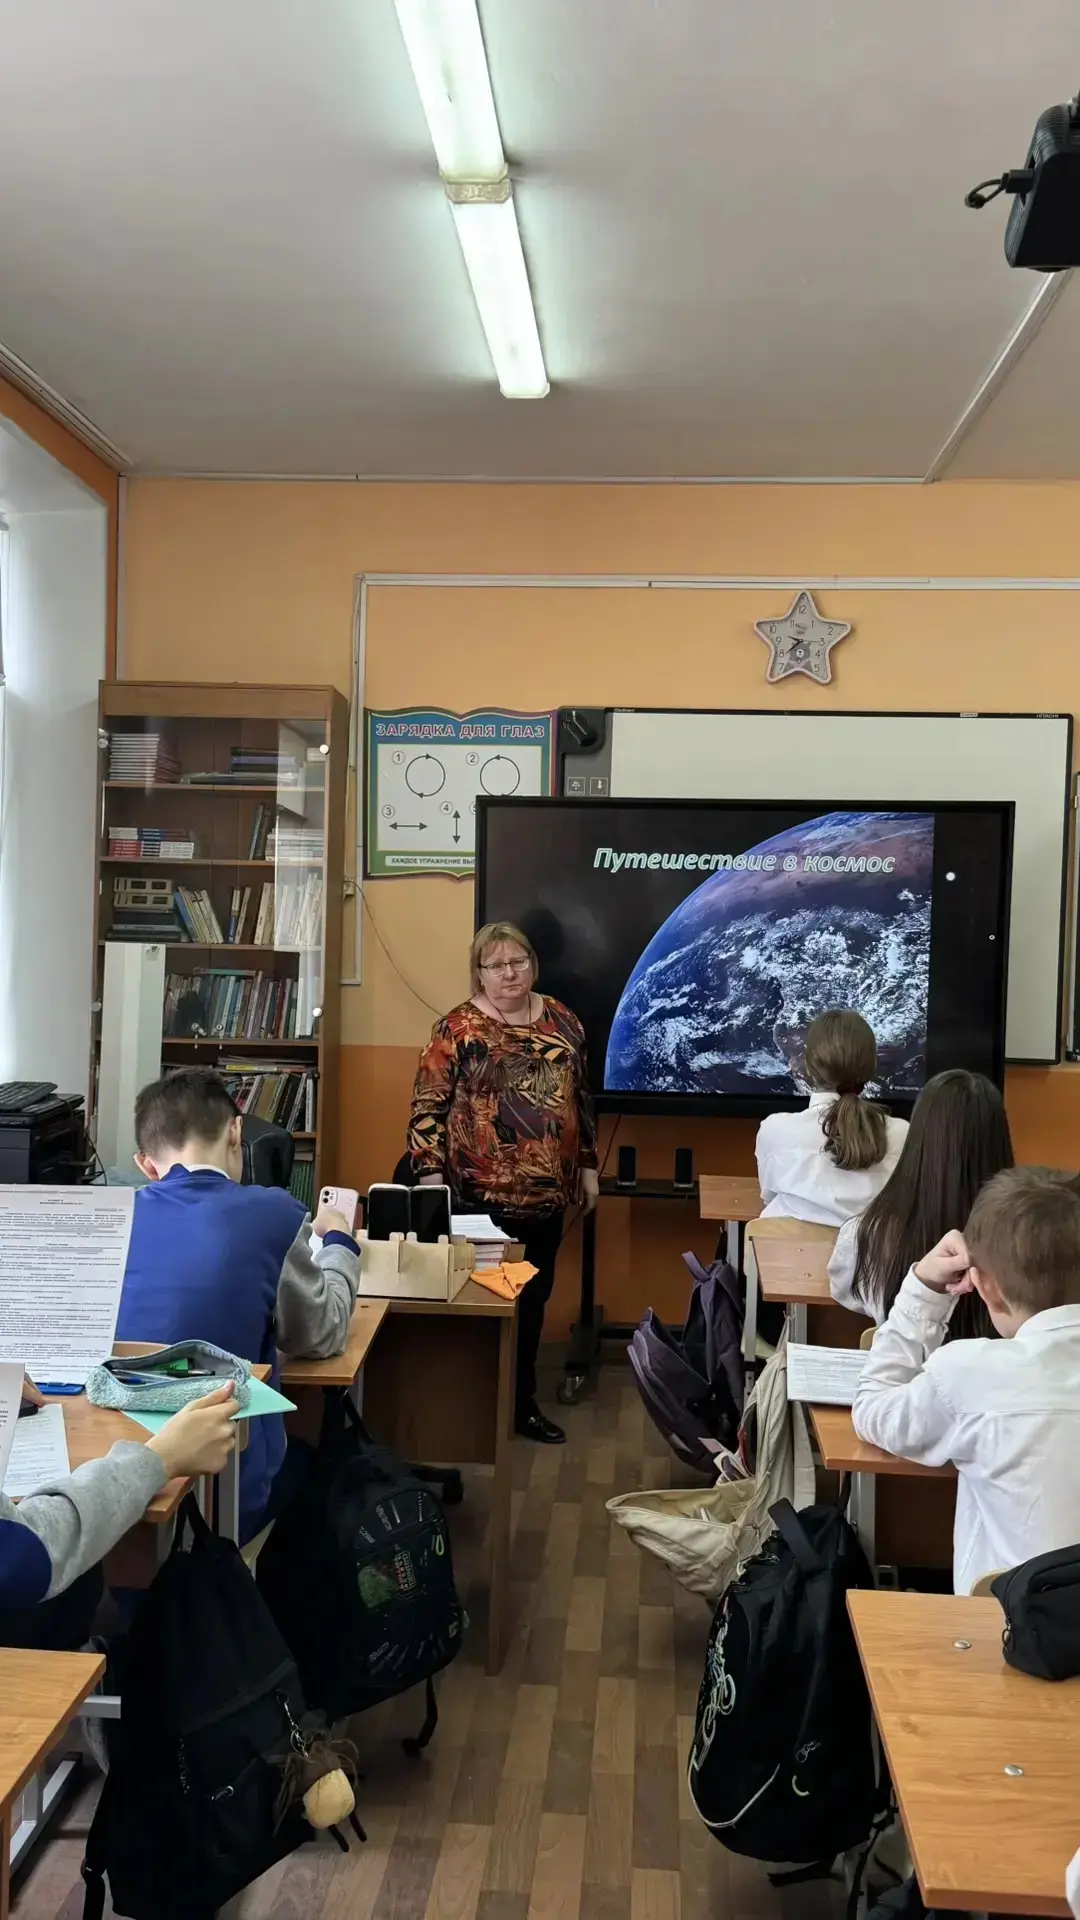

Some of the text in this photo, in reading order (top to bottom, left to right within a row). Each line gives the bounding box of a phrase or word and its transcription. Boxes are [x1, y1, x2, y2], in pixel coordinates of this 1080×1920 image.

[798, 605, 807, 614] 12
[769, 625, 777, 634] 10
[827, 627, 834, 635] 2
[775, 636, 782, 644] 9
[819, 638, 826, 646] 3
[778, 649, 785, 657] 8
[815, 650, 821, 658] 4
[778, 663, 784, 671] 7
[814, 664, 820, 672] 5
[375, 723, 545, 739] ЗАРЯДКА ДЛЯ ГЛАЗ
[469, 755, 476, 763] 2
[385, 807, 392, 816] 3
[593, 848, 896, 873] Путешествие в космос
